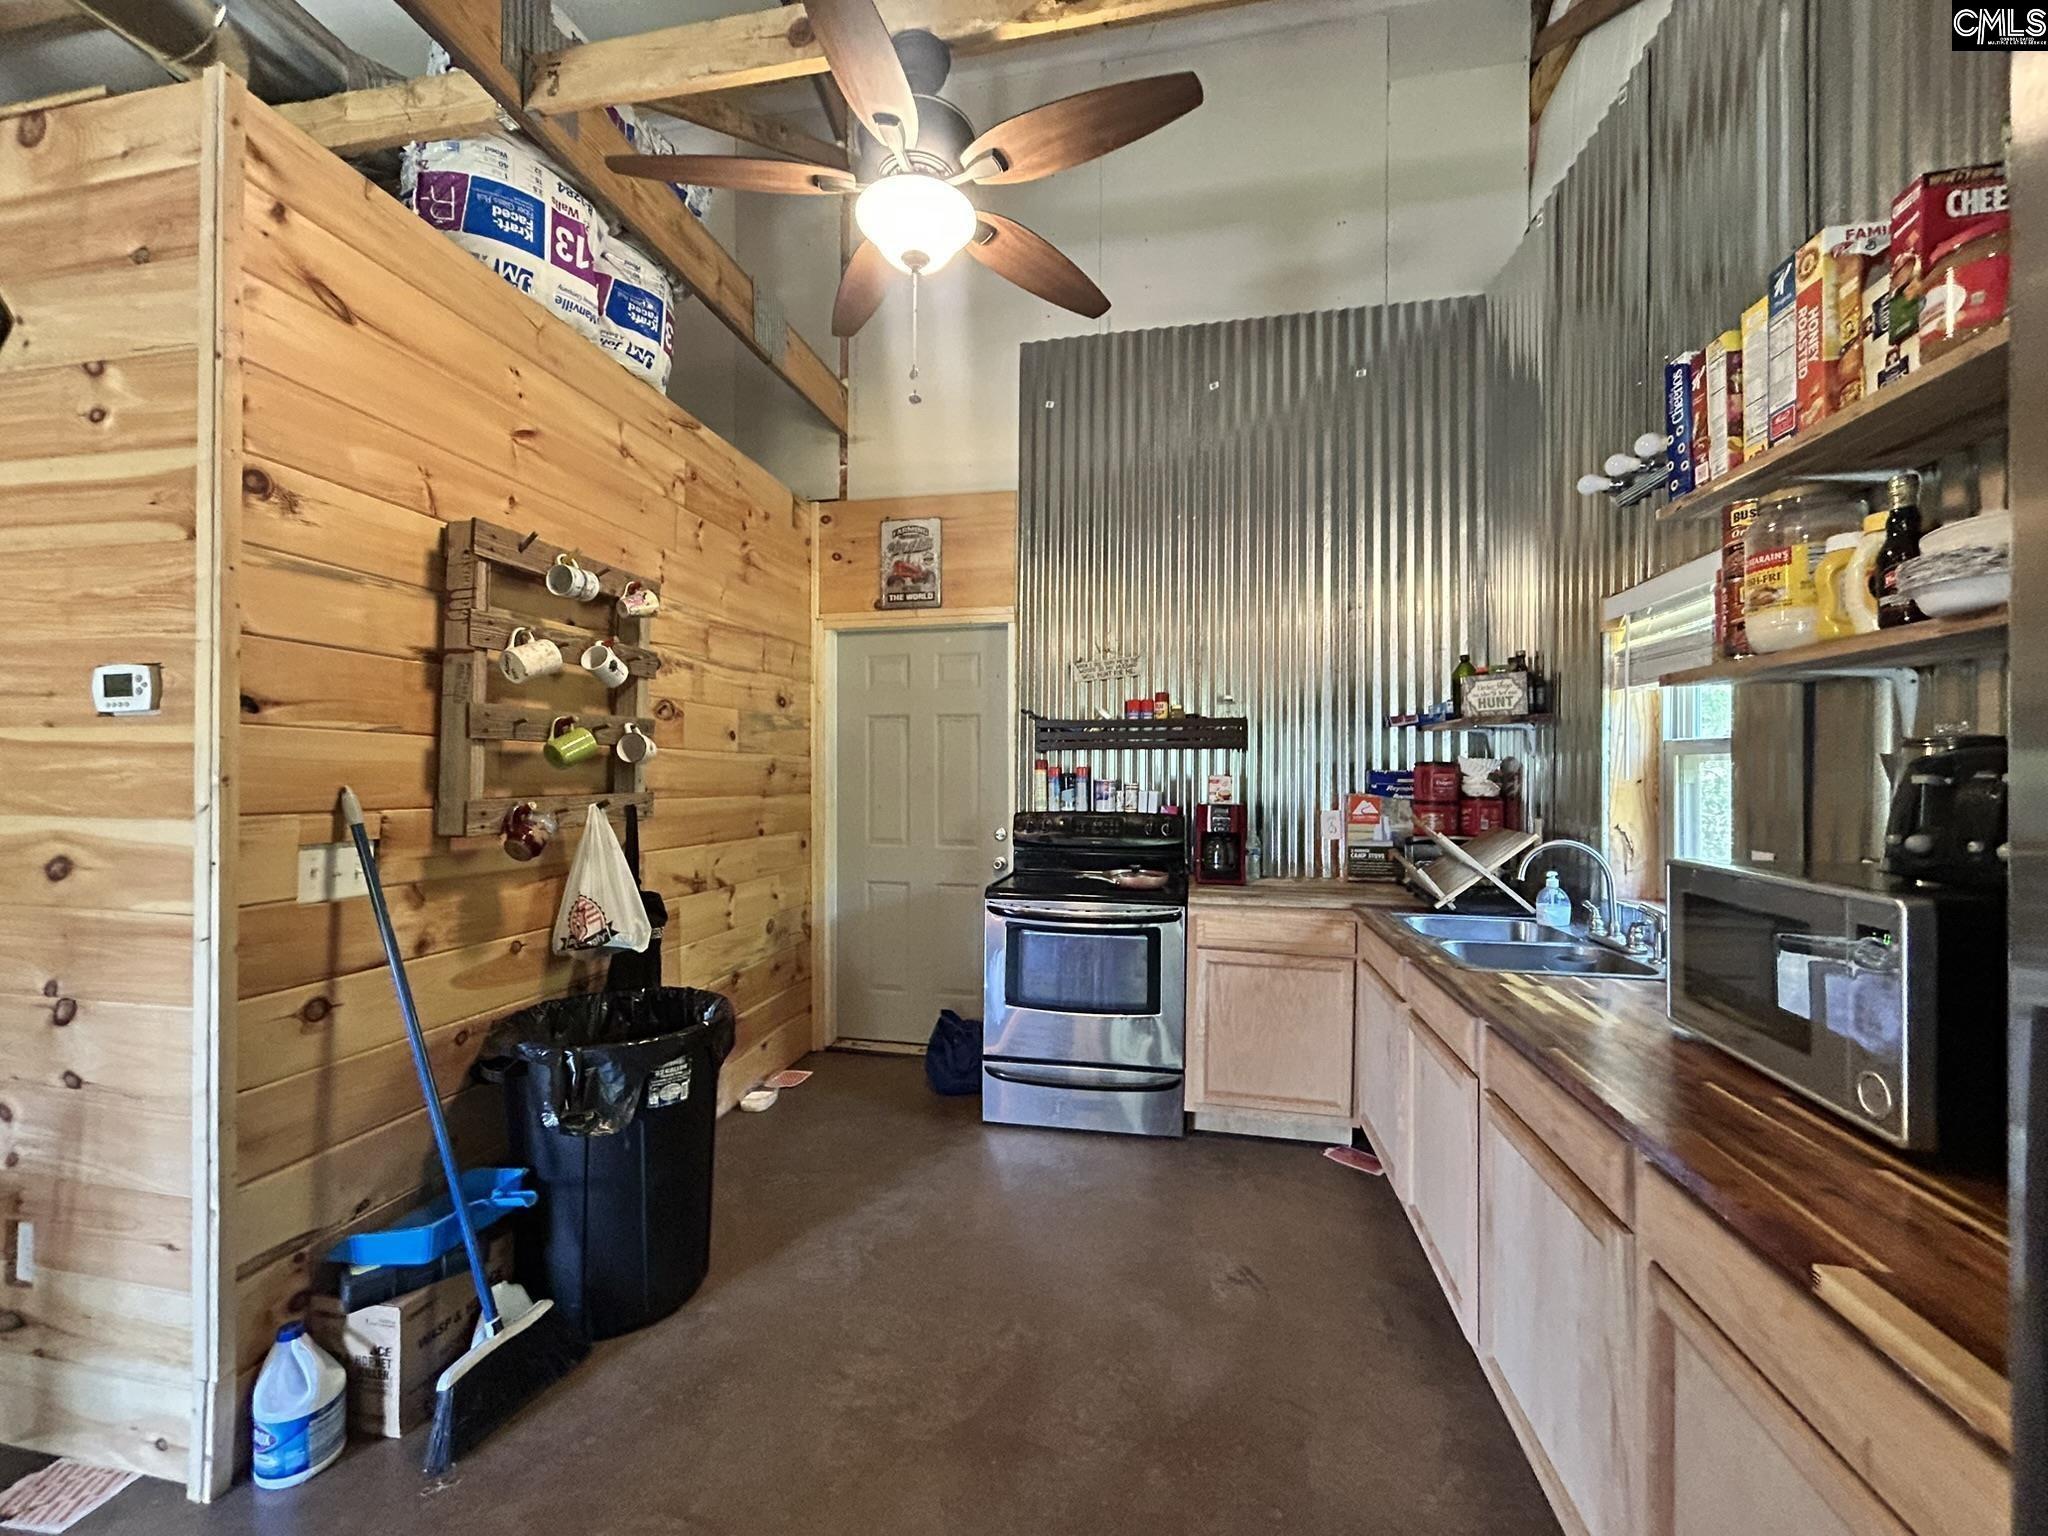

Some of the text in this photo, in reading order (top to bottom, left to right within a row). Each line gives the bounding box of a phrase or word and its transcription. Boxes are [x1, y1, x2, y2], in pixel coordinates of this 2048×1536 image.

[492, 205, 534, 230] Faced
[551, 196, 580, 219] Walls
[492, 218, 534, 243] Kraft-
[555, 226, 590, 270] 13
[493, 258, 535, 293] JM
[626, 301, 659, 324] Faced
[627, 313, 659, 332] Kraft-
[1797, 304, 1809, 379] ROASTED
[1807, 305, 1820, 362] HONEY
[1671, 368, 1684, 425] Cheerios
[906, 592, 934, 600] WORLD
[1478, 695, 1513, 709] HUNT
